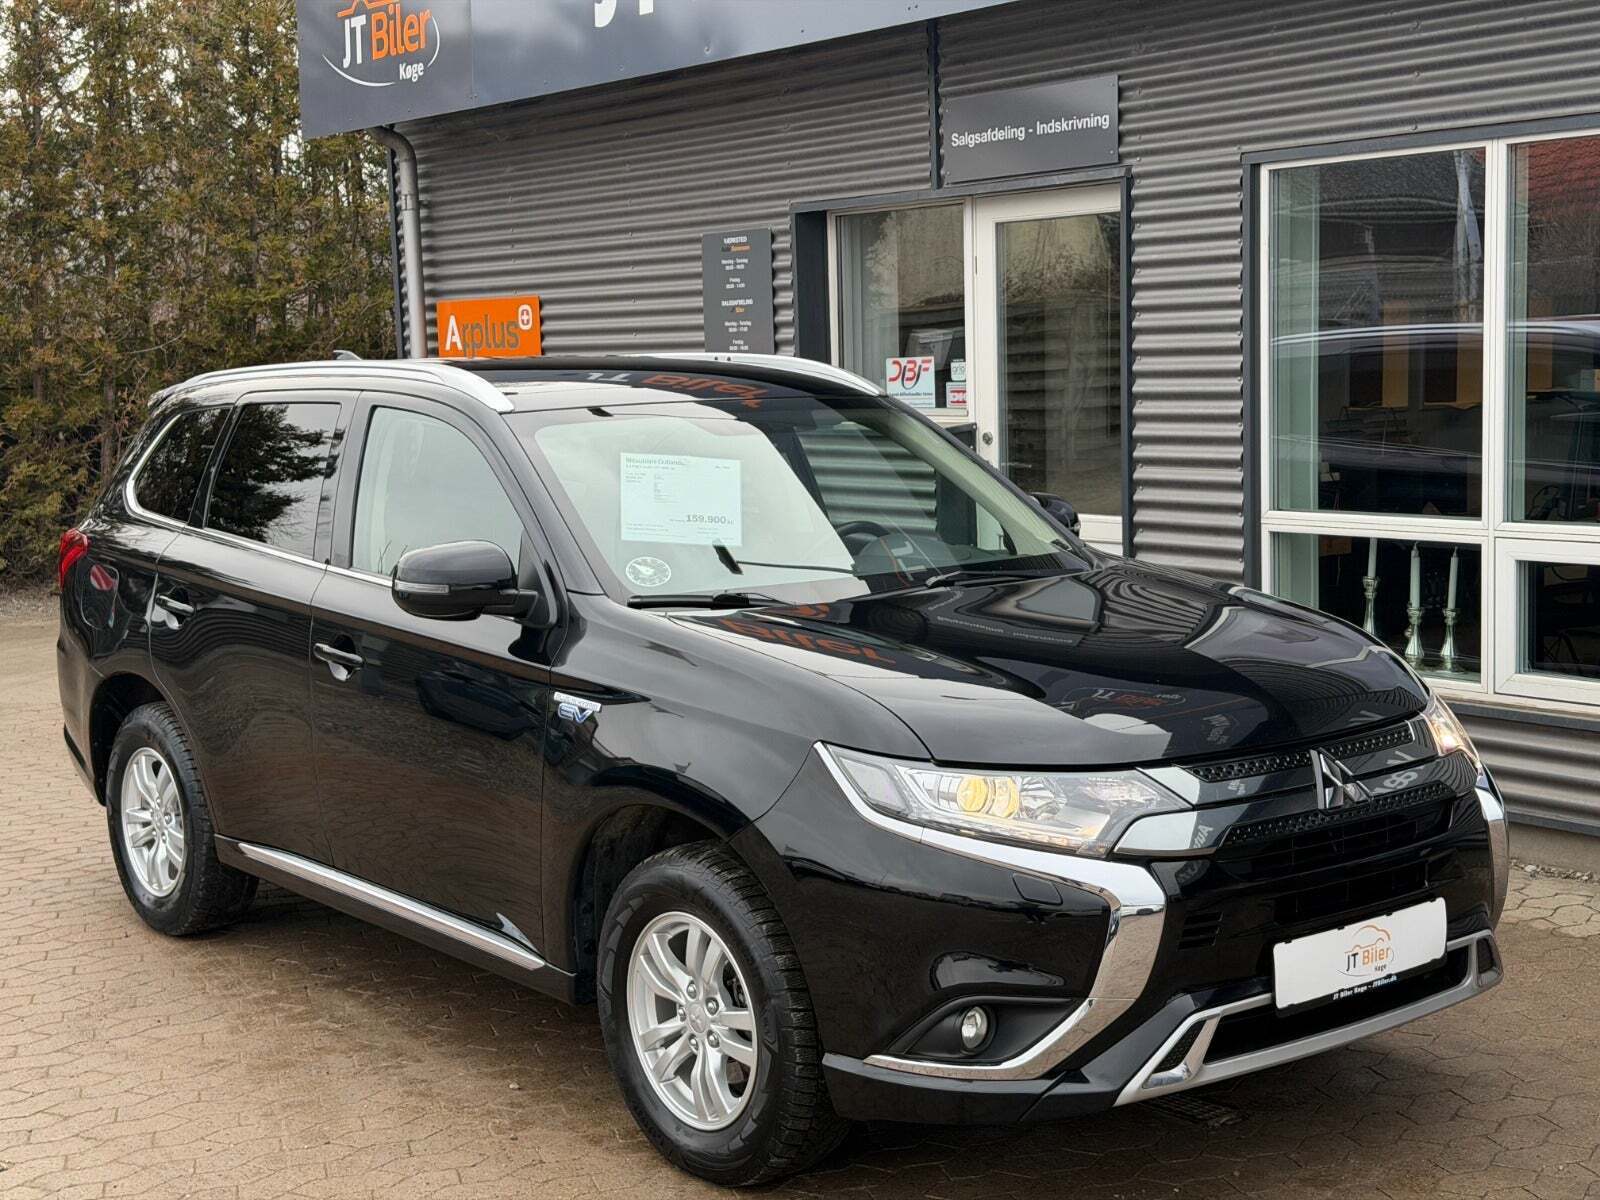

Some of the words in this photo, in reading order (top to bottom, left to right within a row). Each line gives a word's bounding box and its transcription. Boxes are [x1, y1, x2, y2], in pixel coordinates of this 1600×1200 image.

[342, 14, 367, 69] JT
[371, 3, 432, 61] Biler
[399, 62, 424, 82] Køge
[951, 125, 1026, 148] Salgsafdeling
[1036, 113, 1110, 136] Indskrivning
[686, 514, 727, 525] 159.900
[1346, 952, 1359, 972] JT
[1362, 947, 1390, 966] Biler
